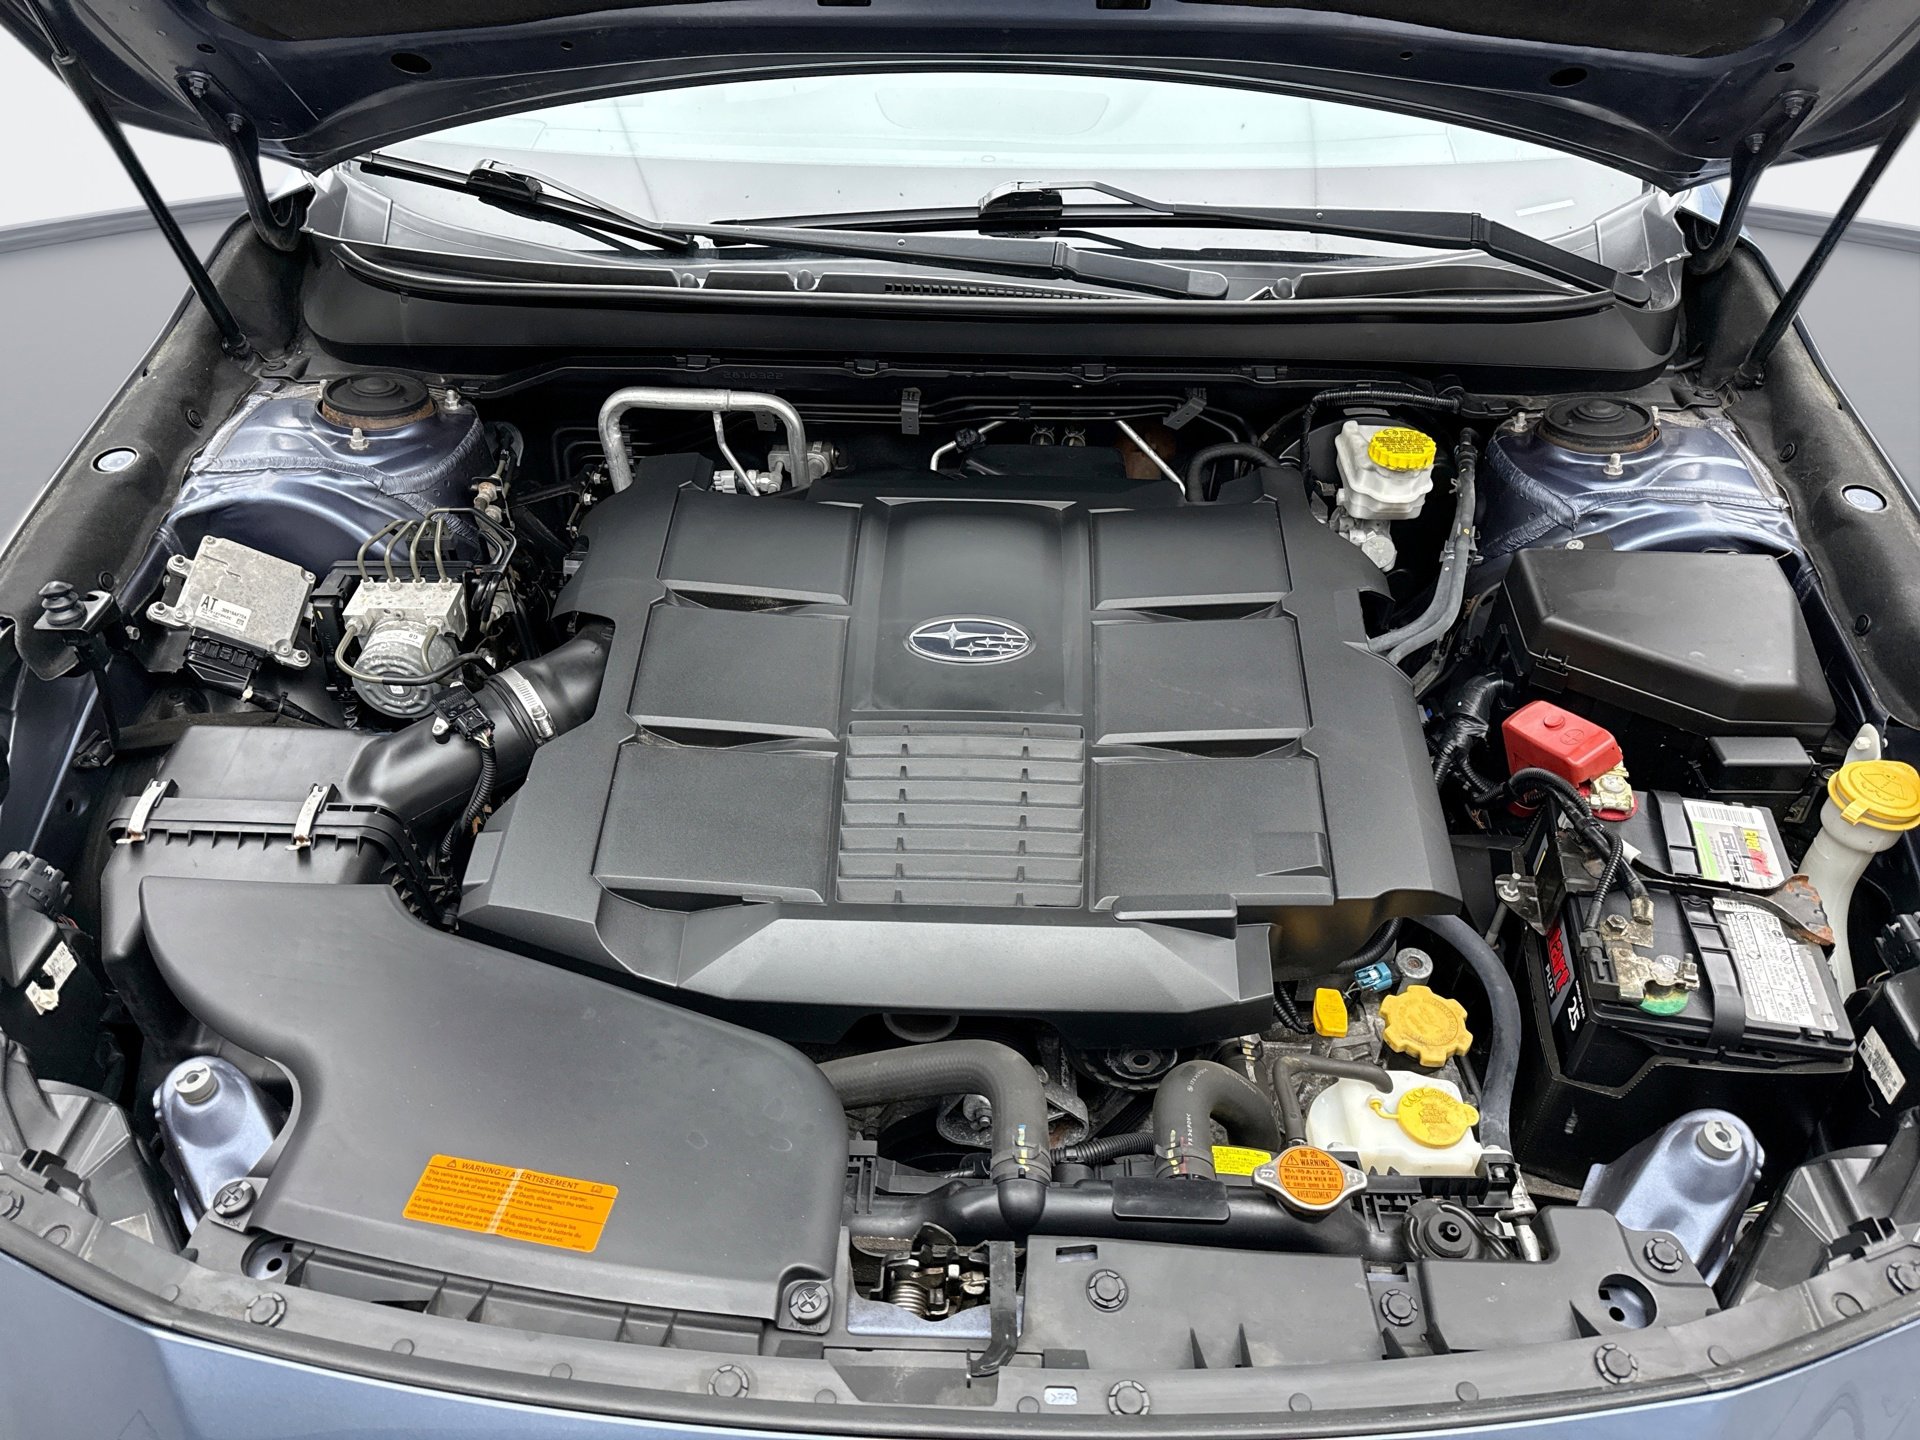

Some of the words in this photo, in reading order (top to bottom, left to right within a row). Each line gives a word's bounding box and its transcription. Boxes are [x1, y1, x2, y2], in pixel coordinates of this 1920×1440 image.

[201, 595, 219, 610] AT
[1545, 963, 1556, 998] PLUS
[1567, 996, 1581, 1032] 25
[1300, 1159, 1330, 1168] WARNING
